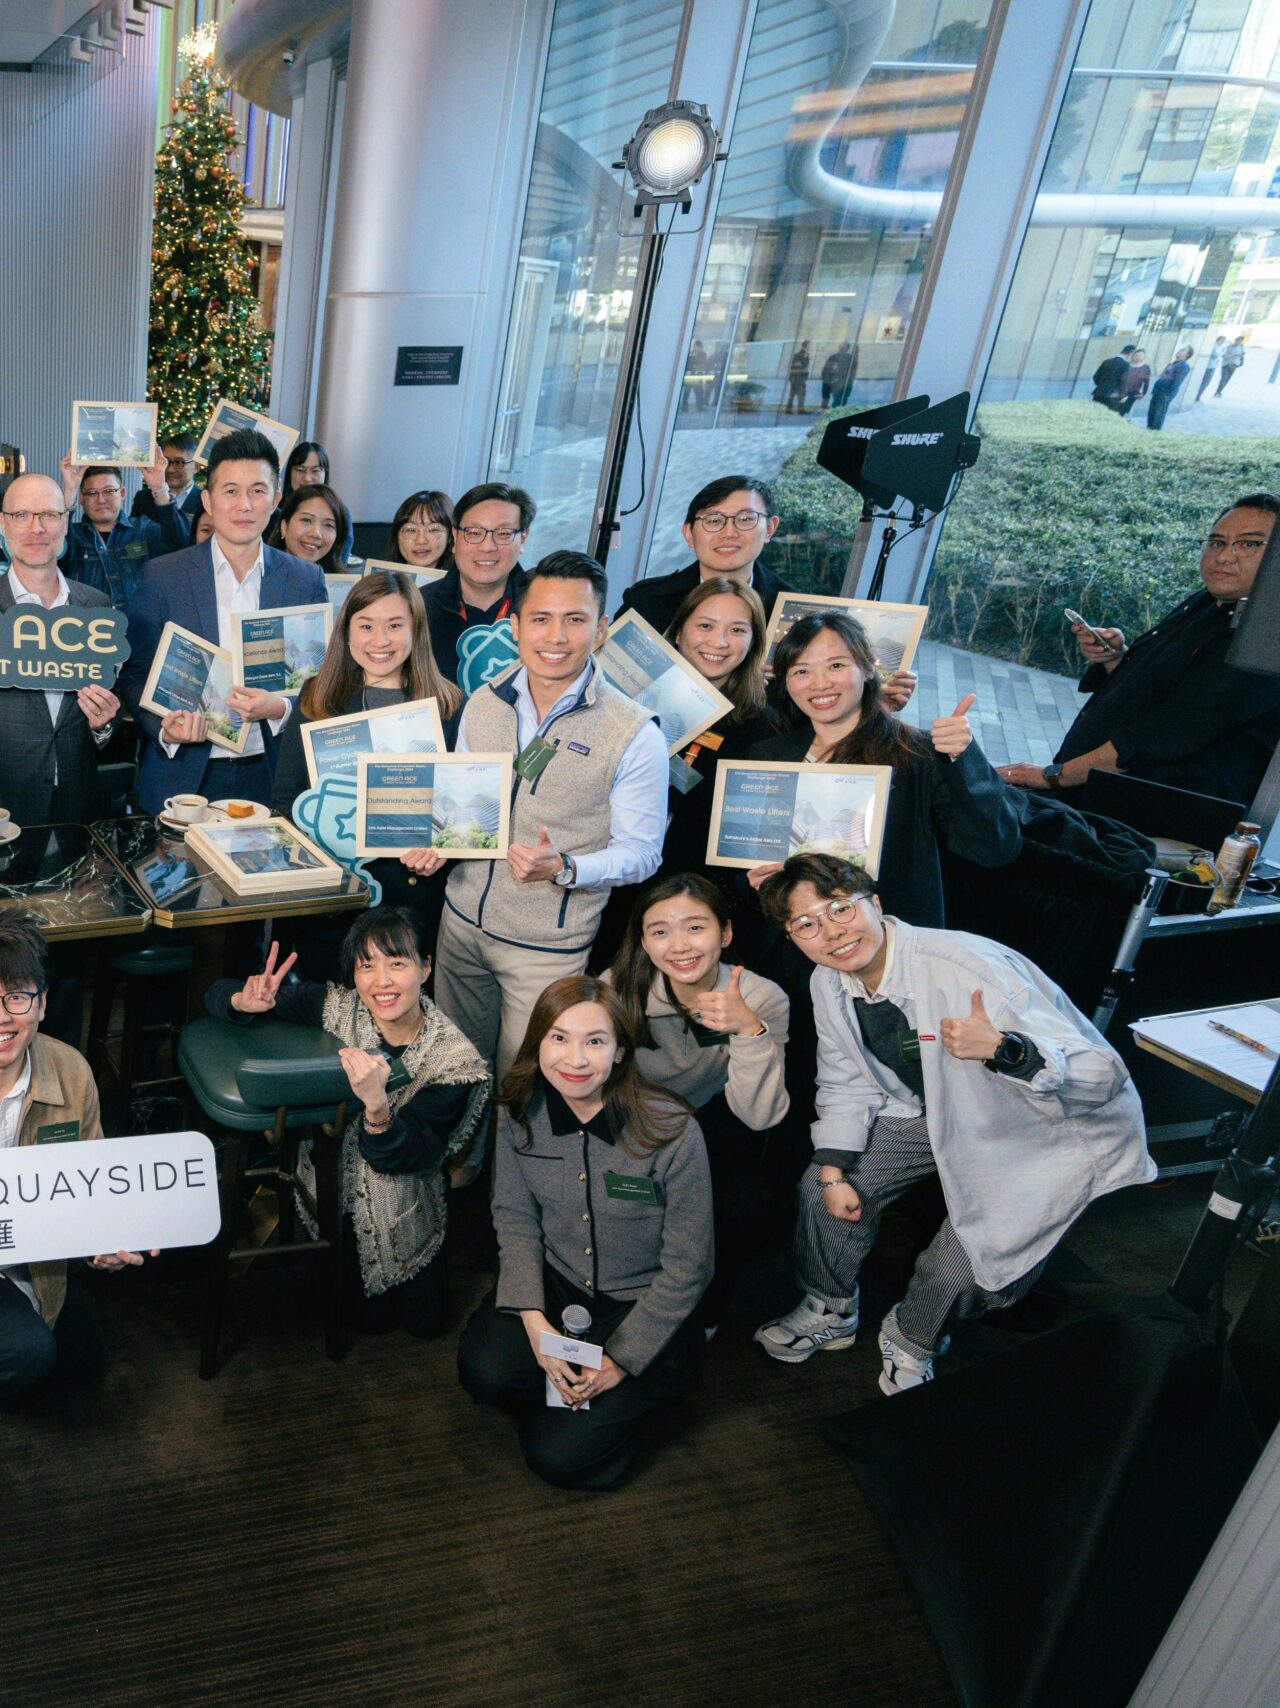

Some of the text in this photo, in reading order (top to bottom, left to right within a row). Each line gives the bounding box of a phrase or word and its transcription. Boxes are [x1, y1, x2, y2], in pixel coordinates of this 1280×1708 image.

[847, 426, 880, 440] SHU
[891, 432, 940, 446] SHURE
[14, 615, 117, 654] ACE
[17, 661, 102, 679] WASTE
[742, 807, 766, 815] Waste
